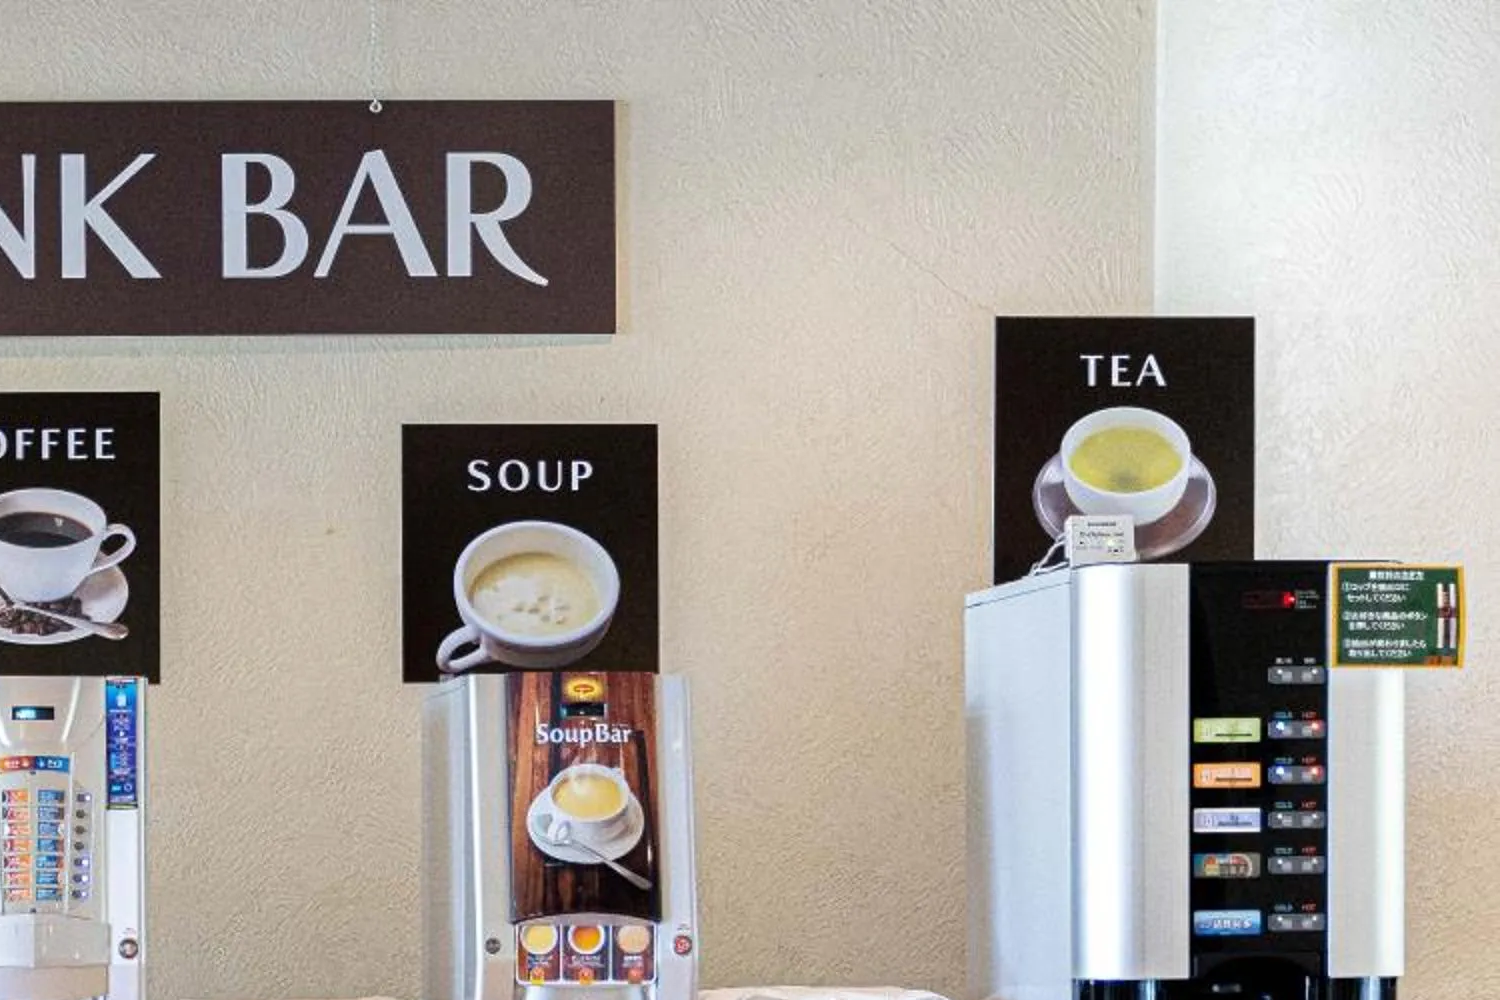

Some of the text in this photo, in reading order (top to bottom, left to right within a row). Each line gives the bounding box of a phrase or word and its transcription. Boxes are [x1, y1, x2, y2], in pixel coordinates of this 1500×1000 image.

[221, 149, 550, 287] BAR
[1079, 353, 1167, 387] TEA
[467, 459, 593, 492] SOUP
